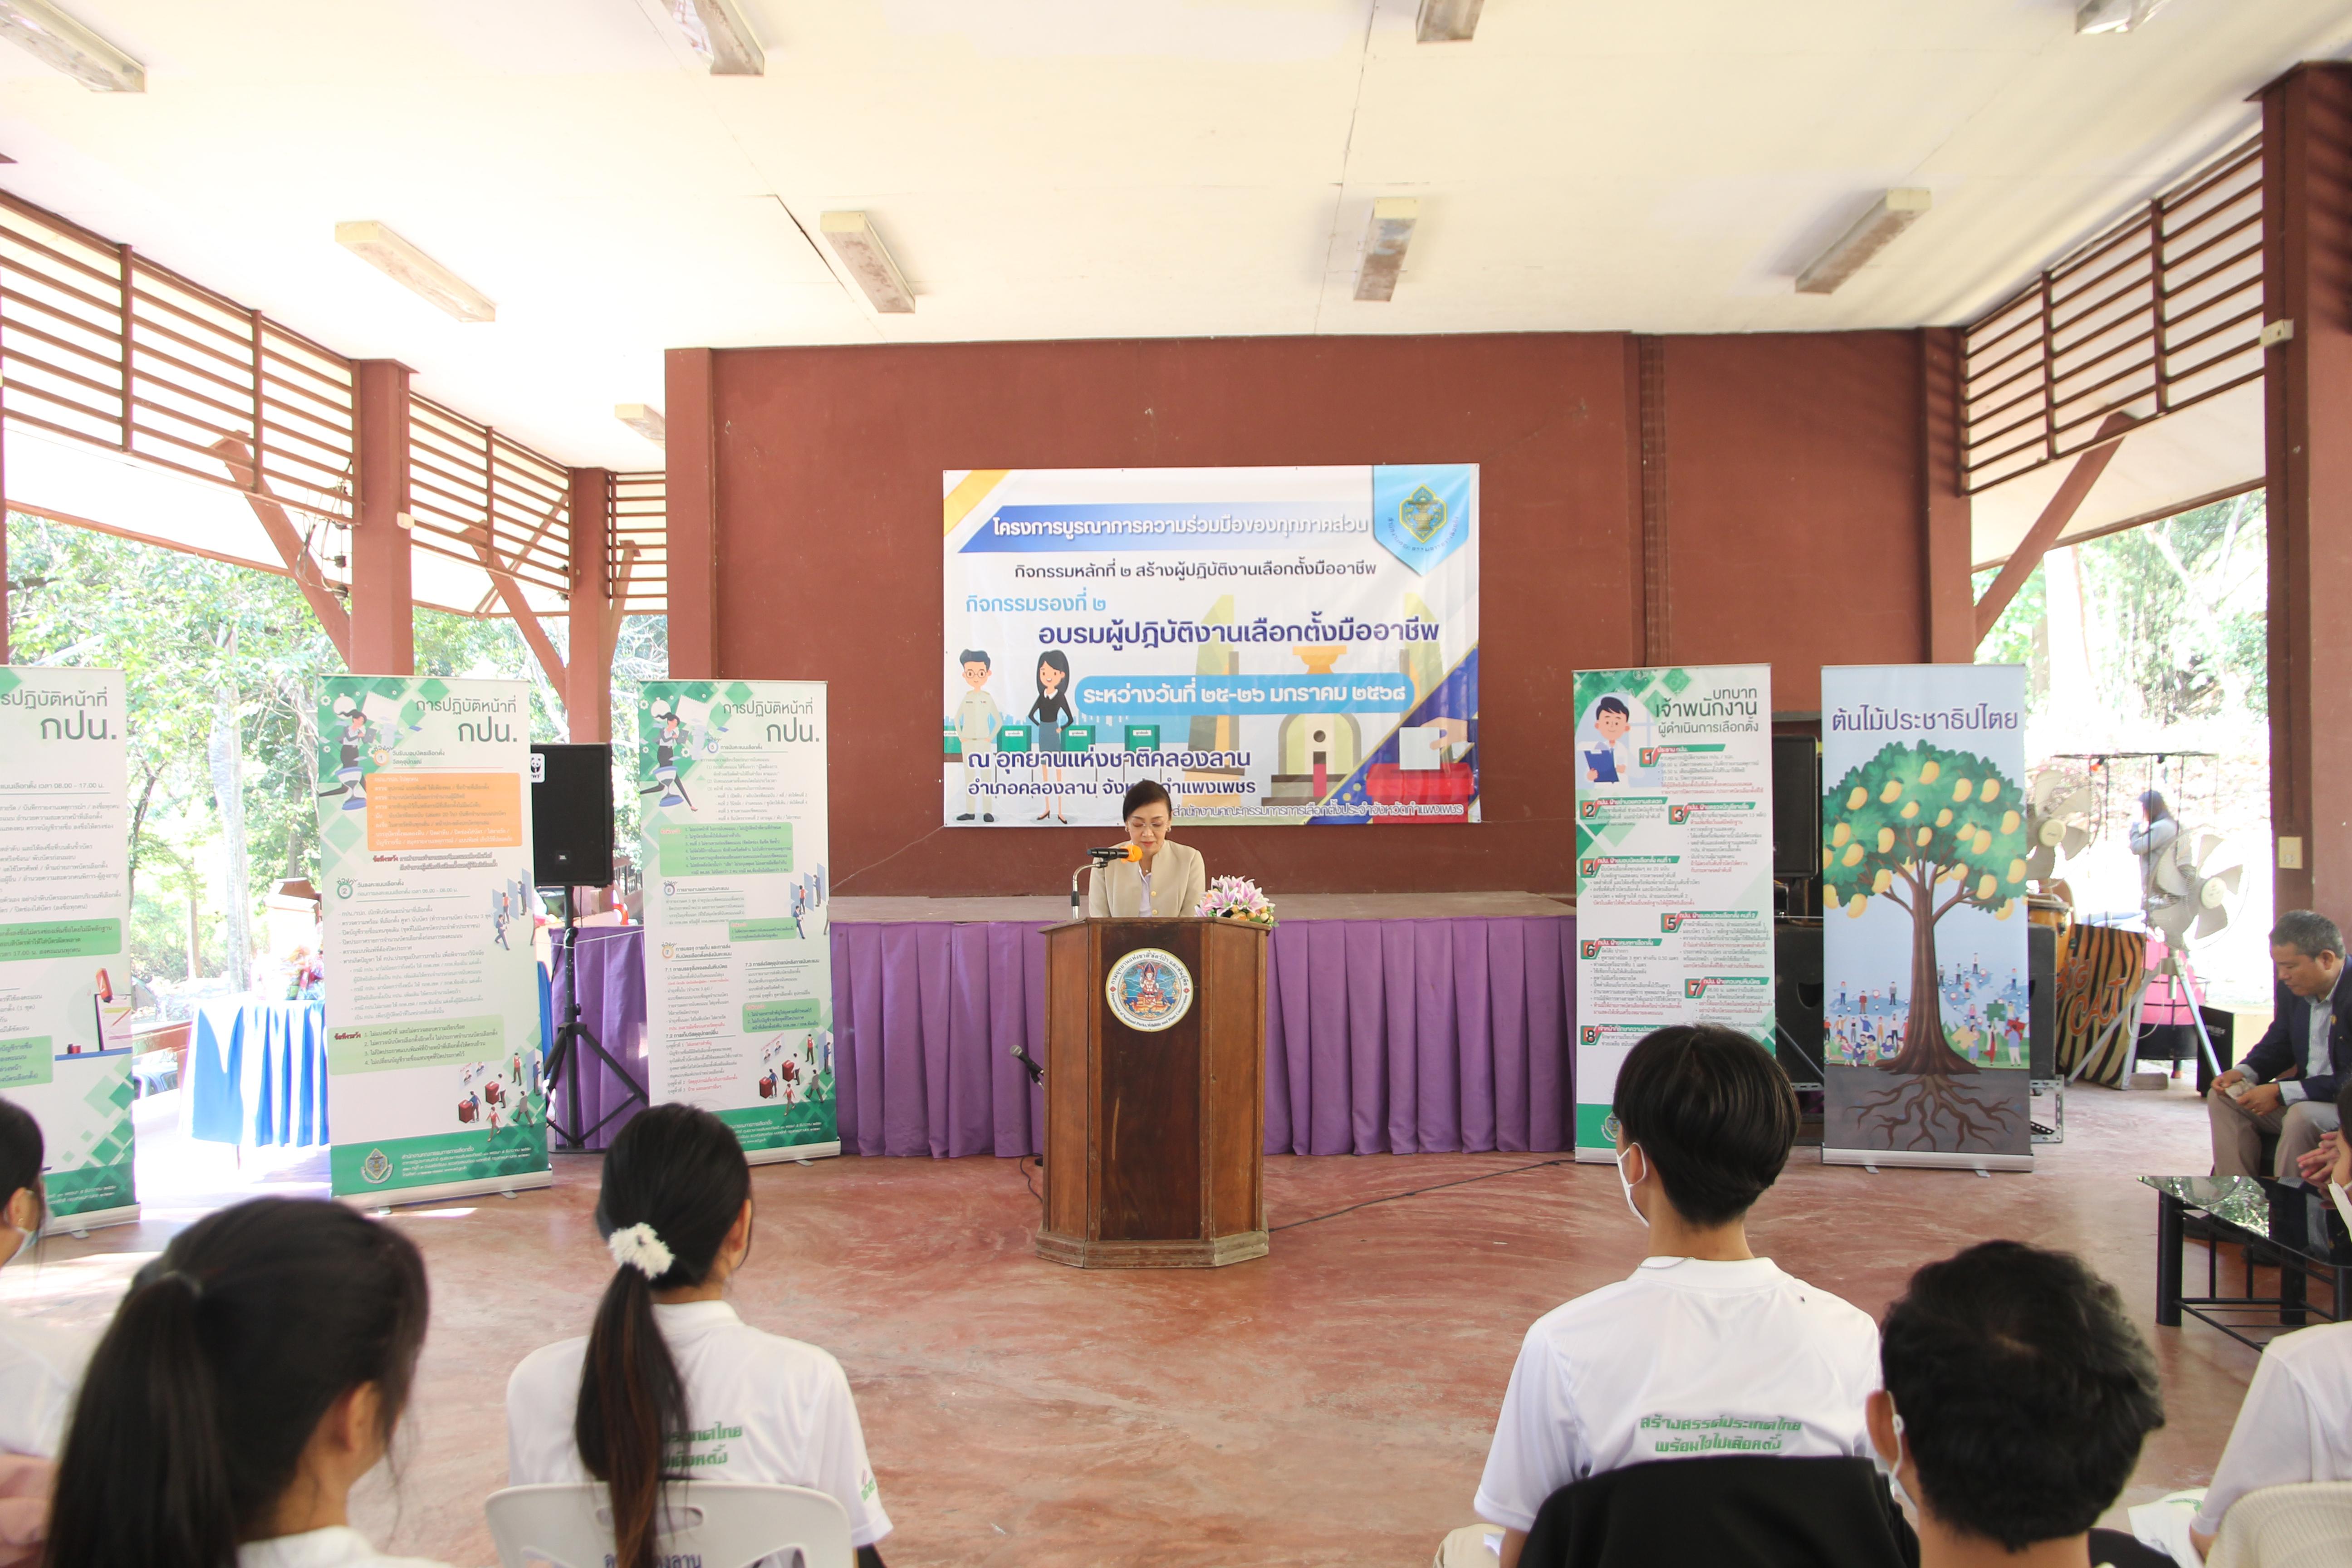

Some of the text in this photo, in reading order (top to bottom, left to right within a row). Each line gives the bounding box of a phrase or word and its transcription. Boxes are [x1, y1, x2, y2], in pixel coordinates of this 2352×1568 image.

[992, 514, 1368, 540] โครงการบูรณาการความร่วมมือของทุกภาคส่วน
[1015, 556, 1377, 581] กิจกรรมหลักที่ ๒ สร้างผู้ปฏิบัติงานเลือกตั้งมืออาชีพ
[966, 587, 1107, 612] กิจกรรมรองที่ ๒
[1083, 677, 1406, 704] ระหว่างวันที่ ๒๕-๒๖ มกราคม ๒๕๖๘
[1712, 687, 1758, 699] บทบาท
[416, 695, 516, 715] การปฏิบัติหน้าที่
[723, 696, 813, 717] การปฏิบัติหน้าที่
[1656, 697, 1758, 717] เจ้าพนักงาน
[40, 710, 118, 740] กปน.
[1658, 716, 1759, 737] ผู้ดำเนินการเลือกตั้ง
[1832, 703, 2019, 731] ต้นไม้ประชาธิปไตย
[458, 715, 518, 743] กปน.
[766, 717, 820, 743] กปน.
[968, 747, 1251, 774] ณ อุทยานแห่งชาติคลองลาน
[1646, 751, 1653, 765] 1
[968, 780, 1098, 795] อำเภอคลองลาน
[1585, 804, 1594, 817] 2
[1674, 809, 1684, 823] 3
[1585, 862, 1595, 876] 4
[1667, 917, 1676, 931] 5
[1586, 944, 1596, 957] 6
[1691, 983, 1700, 996] 7
[1111, 993, 1121, 1013] Department
[1122, 1014, 1136, 1025] National
[1168, 1014, 1176, 1023] Plant
[1176, 995, 1188, 1016] Conservation
[1587, 1029, 1595, 1043] 8
